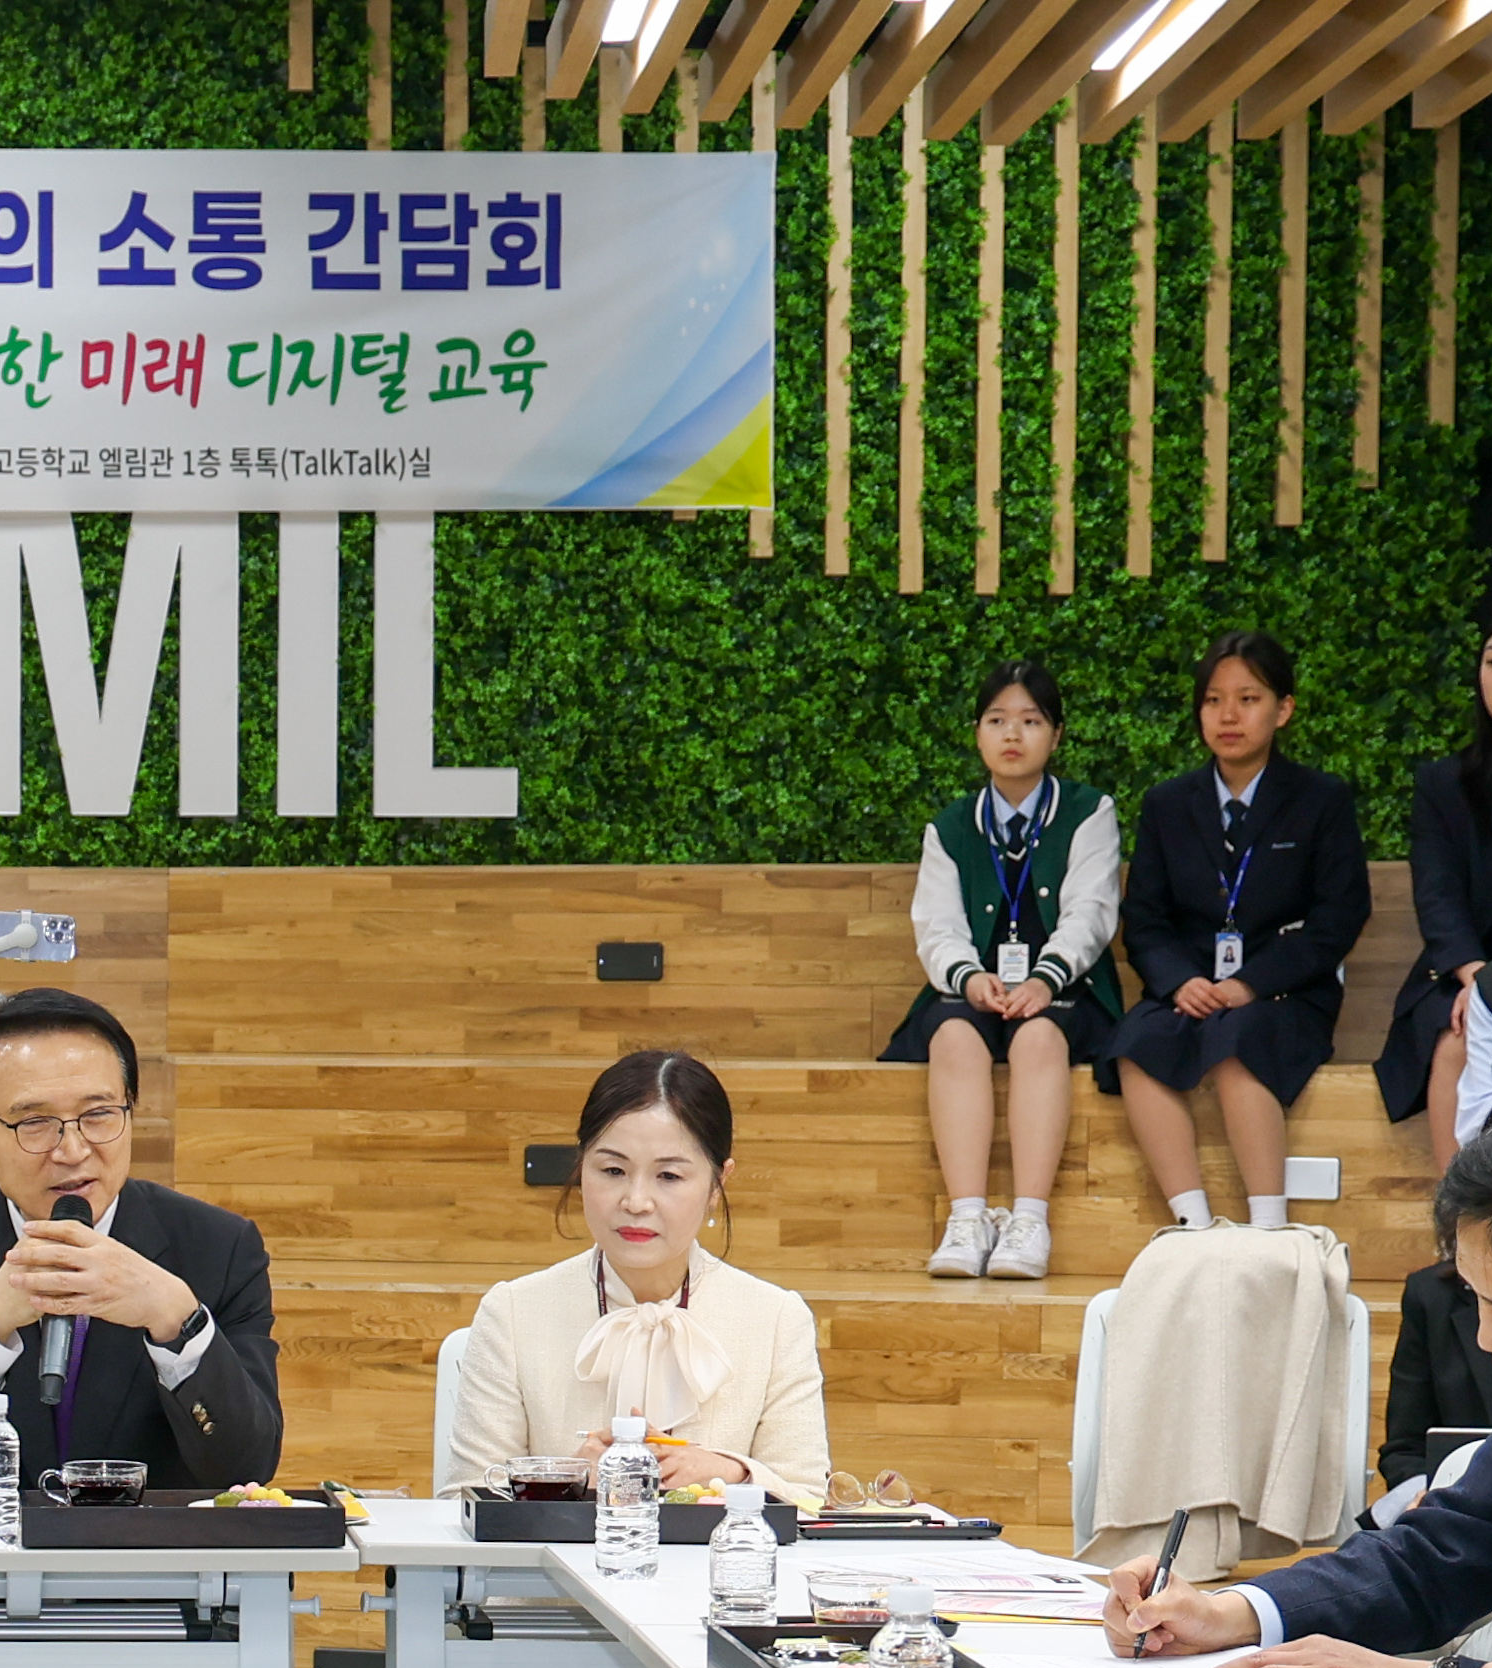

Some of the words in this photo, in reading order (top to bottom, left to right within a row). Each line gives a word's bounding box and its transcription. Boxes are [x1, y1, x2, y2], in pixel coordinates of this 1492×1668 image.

[99, 192, 266, 291] 소통
[308, 191, 561, 292] 간담회
[82, 333, 205, 410] 미래
[227, 332, 410, 414] 디지털
[428, 328, 548, 412] 교육
[98, 447, 174, 479] 엘림관
[183, 447, 222, 479] 1층
[230, 446, 431, 482] 톡톡(TalkTalk)실
